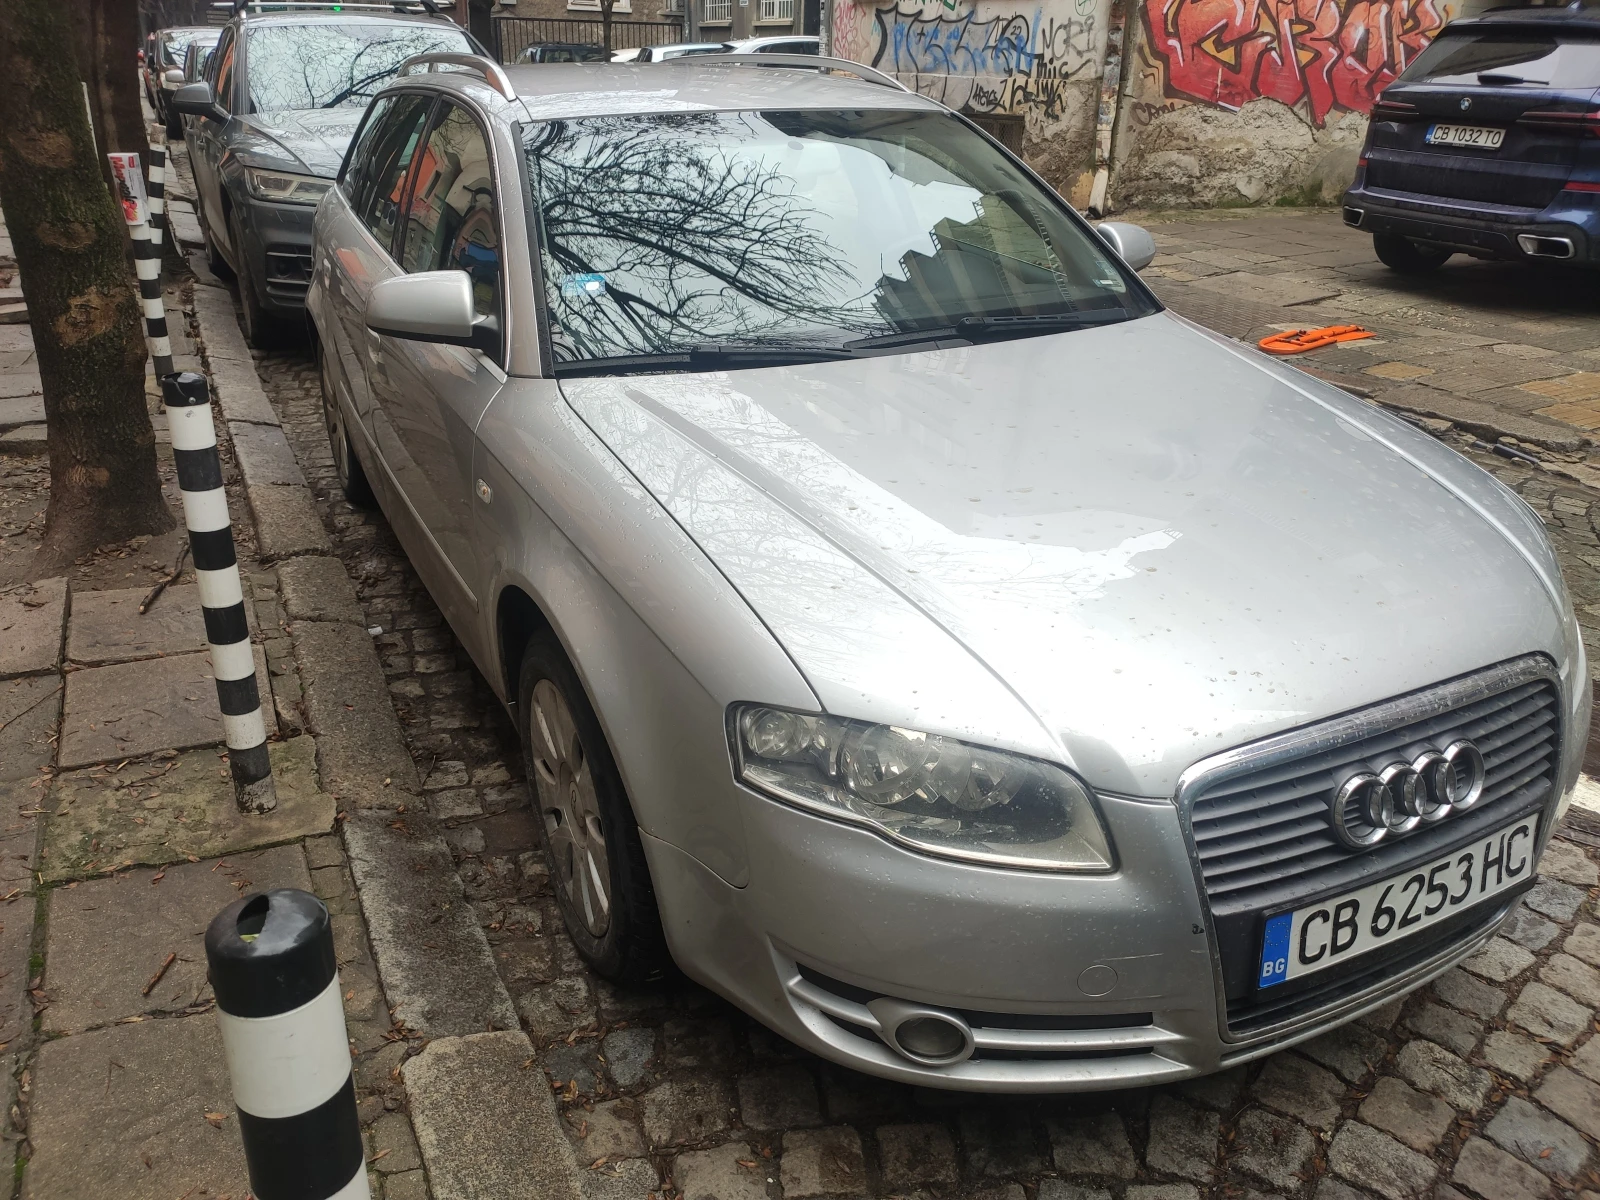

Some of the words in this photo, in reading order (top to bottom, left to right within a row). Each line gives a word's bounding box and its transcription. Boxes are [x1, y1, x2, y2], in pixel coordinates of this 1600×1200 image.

[1433, 126, 1451, 141] CB
[1452, 127, 1482, 143] 1032
[1484, 130, 1502, 145] TO
[1262, 957, 1286, 978] BG
[1298, 898, 1360, 965] CB
[1370, 852, 1474, 938] 6253
[1479, 824, 1531, 894] HC
